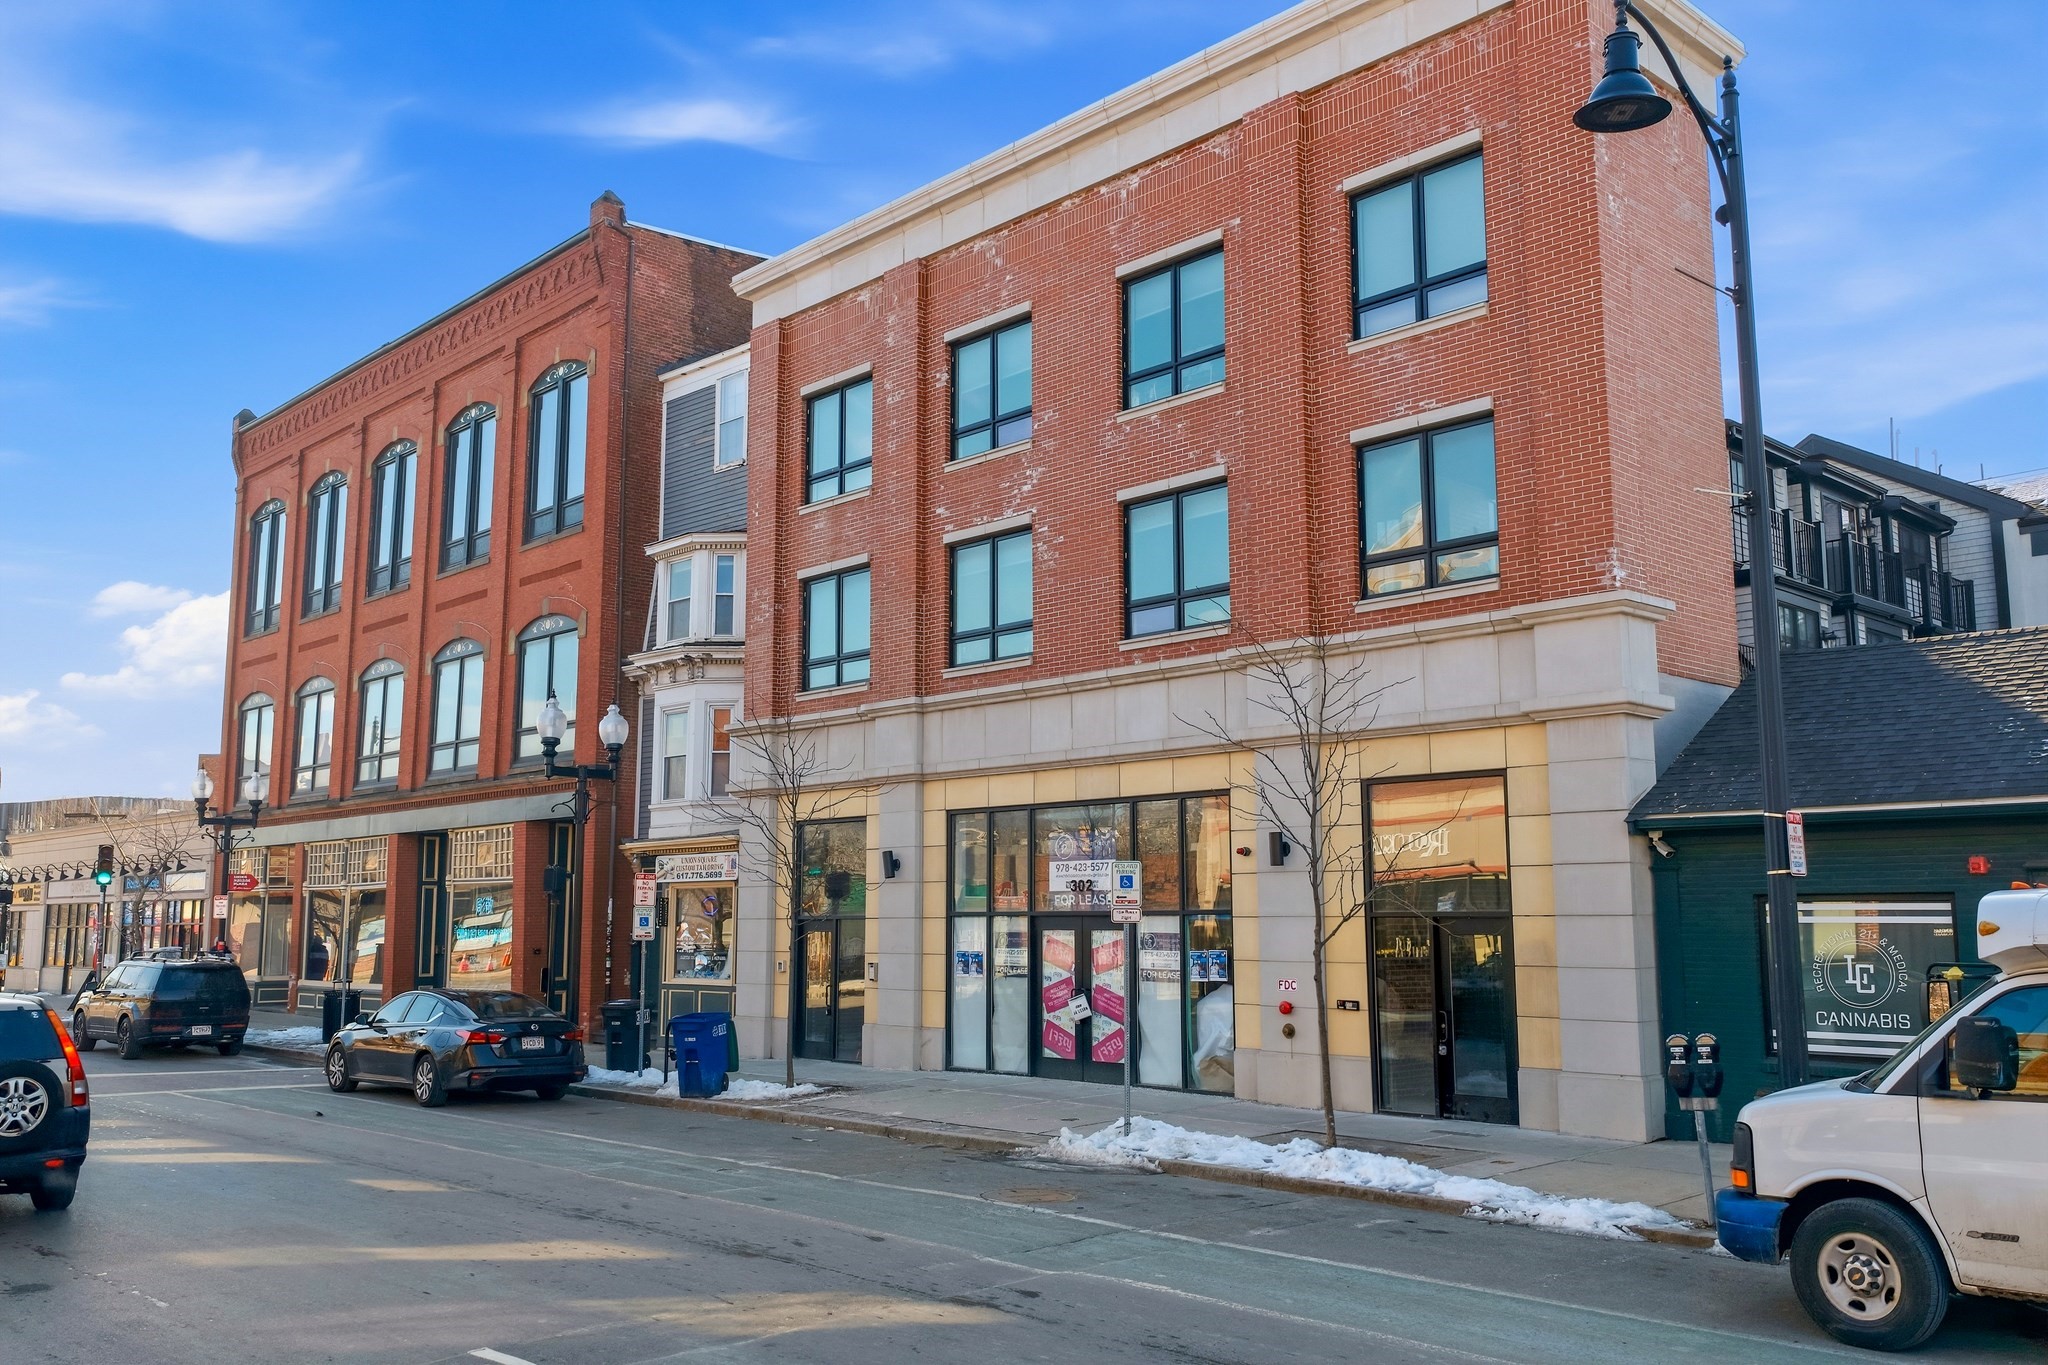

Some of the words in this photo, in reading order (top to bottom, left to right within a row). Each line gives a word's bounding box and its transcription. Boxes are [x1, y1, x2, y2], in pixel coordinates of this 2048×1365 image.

[1056, 862, 1109, 873] 978-423-5577
[676, 871, 722, 880] 617.776.5699
[1070, 879, 1093, 892] 302
[1054, 895, 1076, 905] FOR
[1079, 894, 1111, 905] LEASE
[1812, 929, 1856, 993] RECREATIONAL
[1888, 945, 1908, 993] MEDICAL
[1143, 970, 1157, 979] FOR
[1279, 980, 1297, 990] FDC
[1816, 1011, 1911, 1029] CANNABIS
